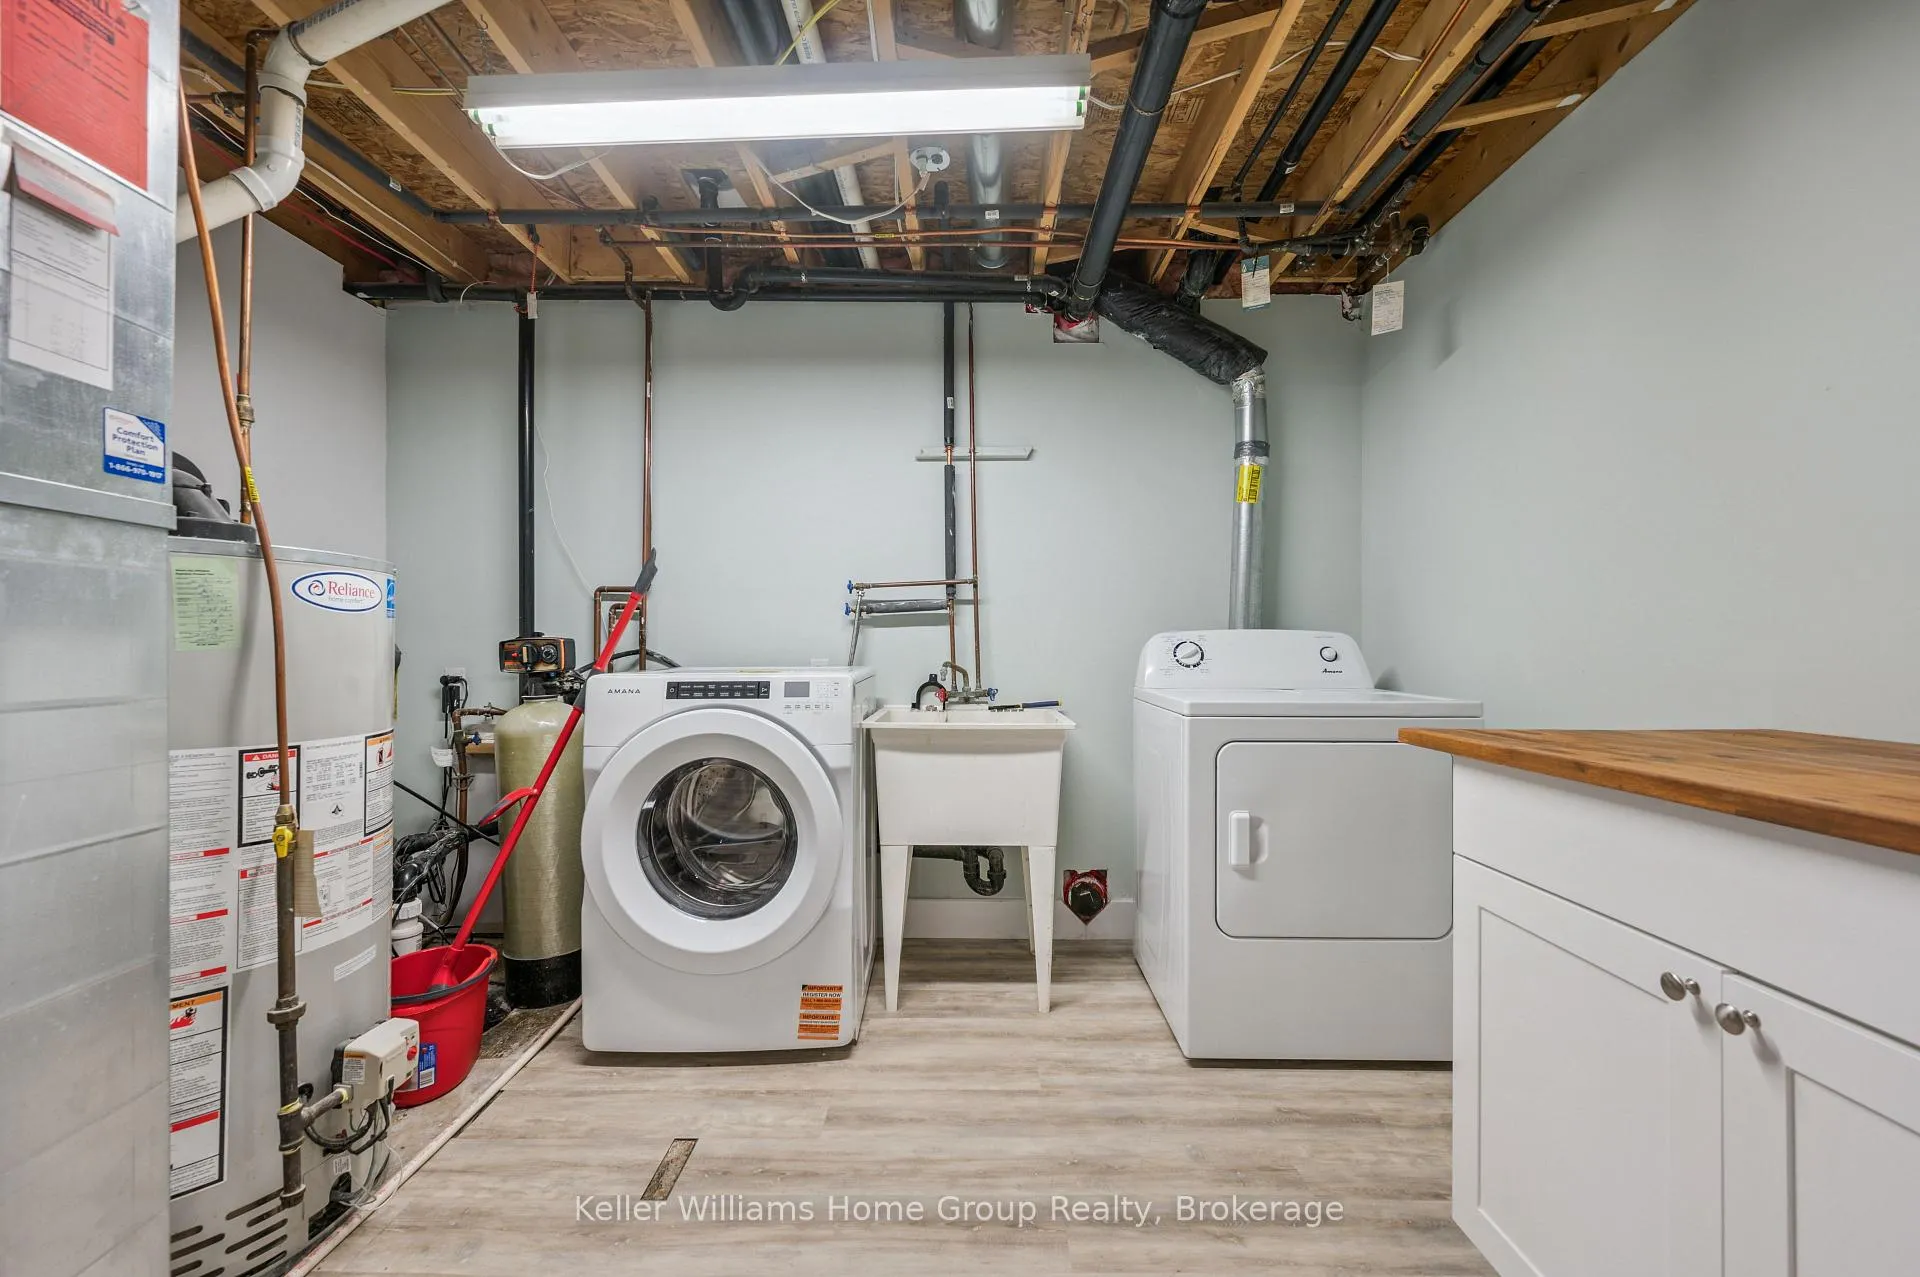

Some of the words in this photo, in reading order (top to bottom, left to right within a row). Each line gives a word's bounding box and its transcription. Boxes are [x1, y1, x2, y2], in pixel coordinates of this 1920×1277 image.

[112, 433, 158, 451] Protection
[116, 427, 154, 442] Comfort
[126, 445, 146, 456] Plan
[328, 580, 375, 599] Reliance
